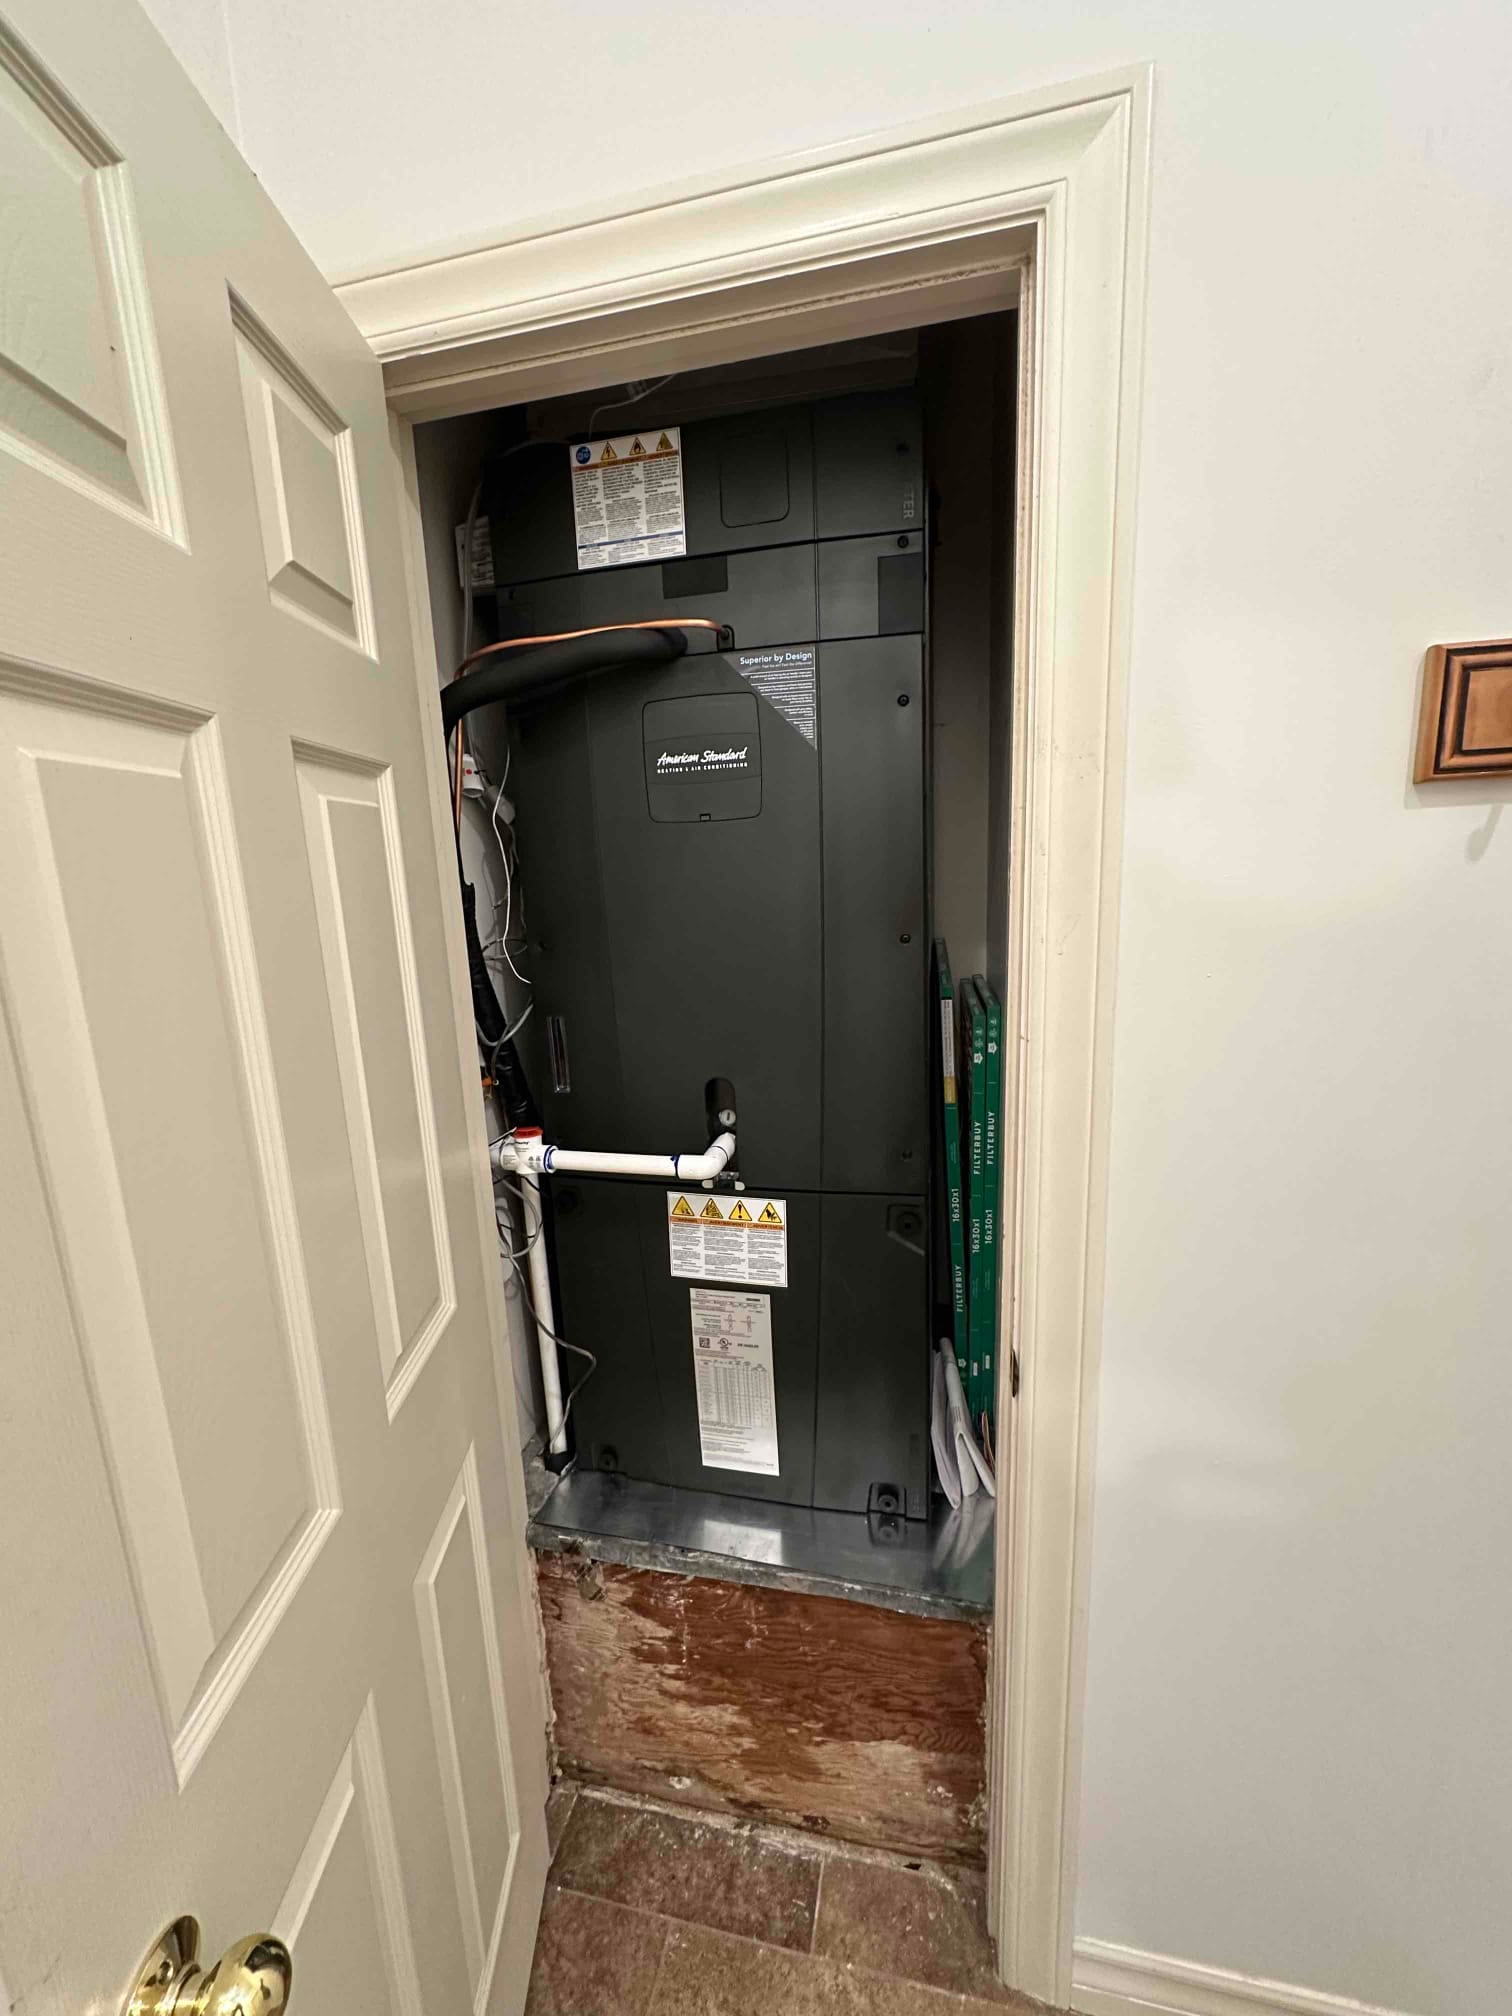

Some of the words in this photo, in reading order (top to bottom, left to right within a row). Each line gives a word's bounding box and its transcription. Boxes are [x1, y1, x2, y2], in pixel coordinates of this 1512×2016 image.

[740, 655, 772, 665] Superior
[774, 653, 784, 663] by
[785, 651, 812, 661] Design
[656, 751, 700, 766] American
[700, 746, 748, 763] Standard
[973, 1121, 981, 1175] FILTERBUY
[986, 1111, 995, 1165] FILTERBUY
[951, 1188, 961, 1222] 16x30x1
[972, 1218, 981, 1253] 16x30x1
[984, 1209, 993, 1244] 16x30x1
[954, 1264, 964, 1313] FILTERBUY
